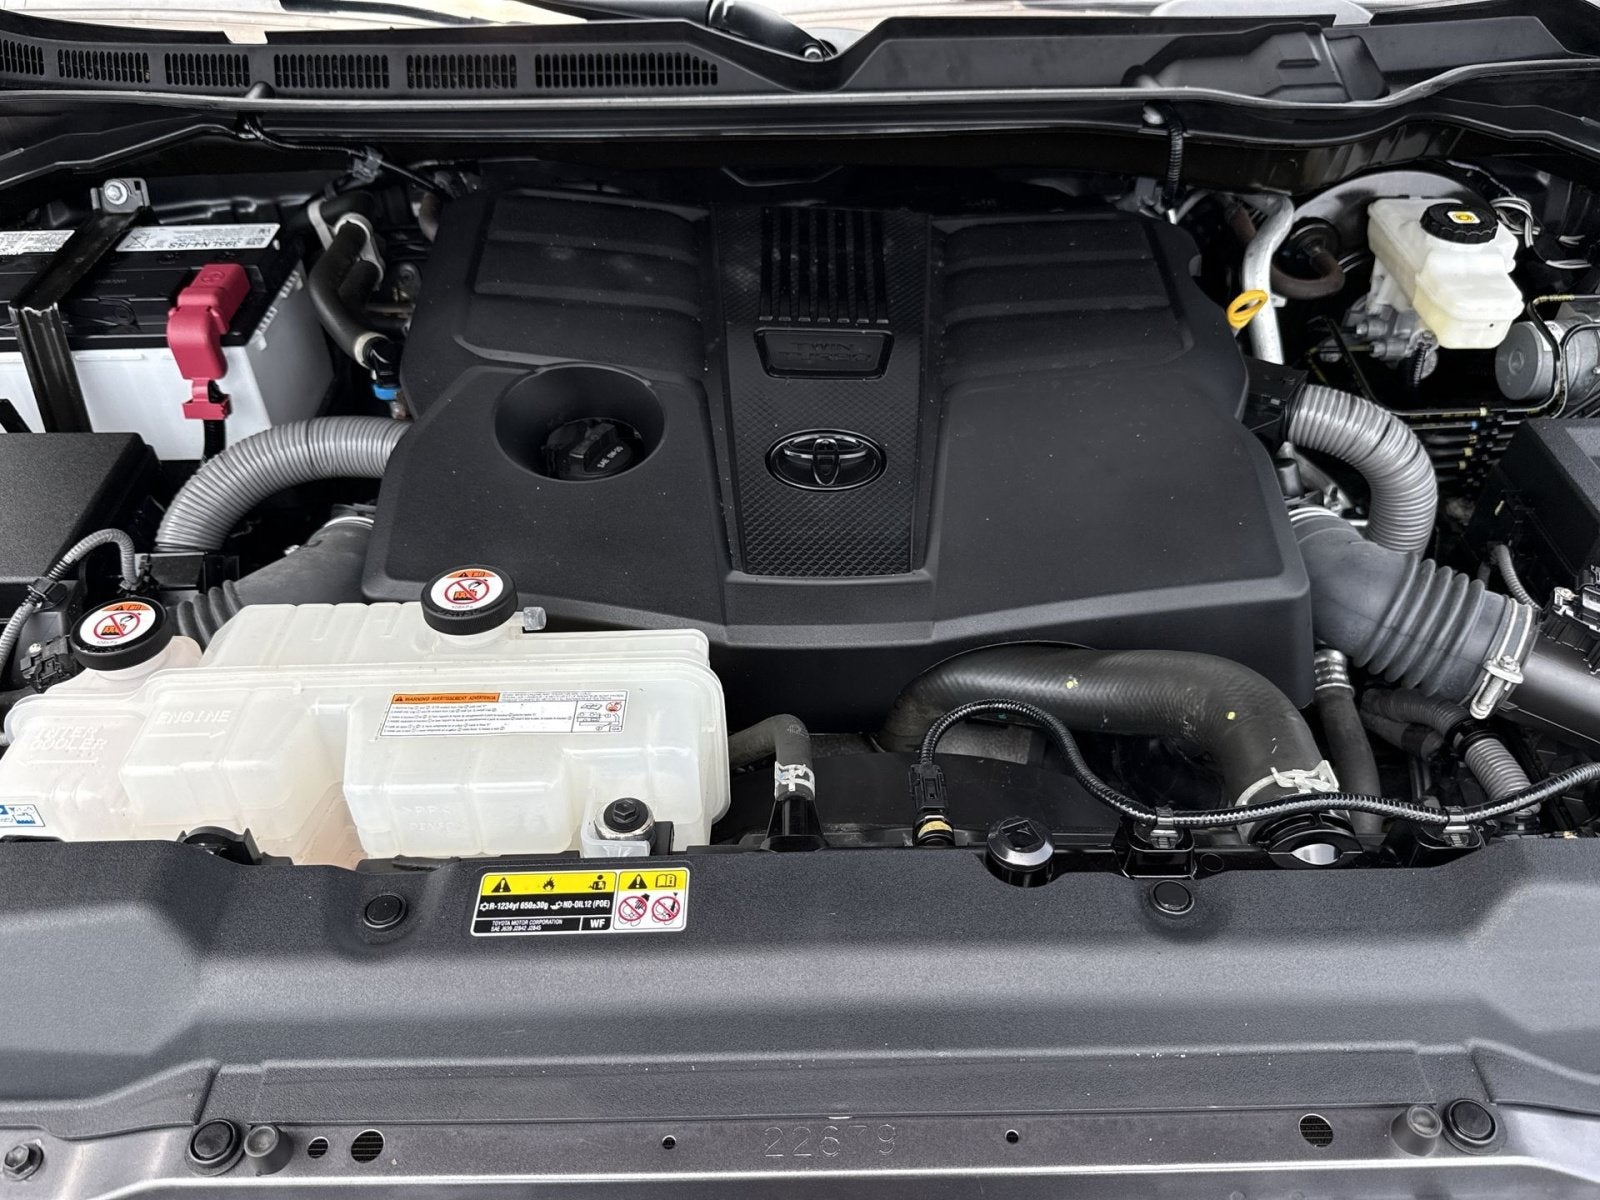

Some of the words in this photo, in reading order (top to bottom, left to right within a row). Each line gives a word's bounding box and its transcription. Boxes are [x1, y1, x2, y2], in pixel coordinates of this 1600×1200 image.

[157, 710, 234, 725] ENGINE
[489, 902, 519, 911] R-1234yf
[590, 919, 606, 928] WF
